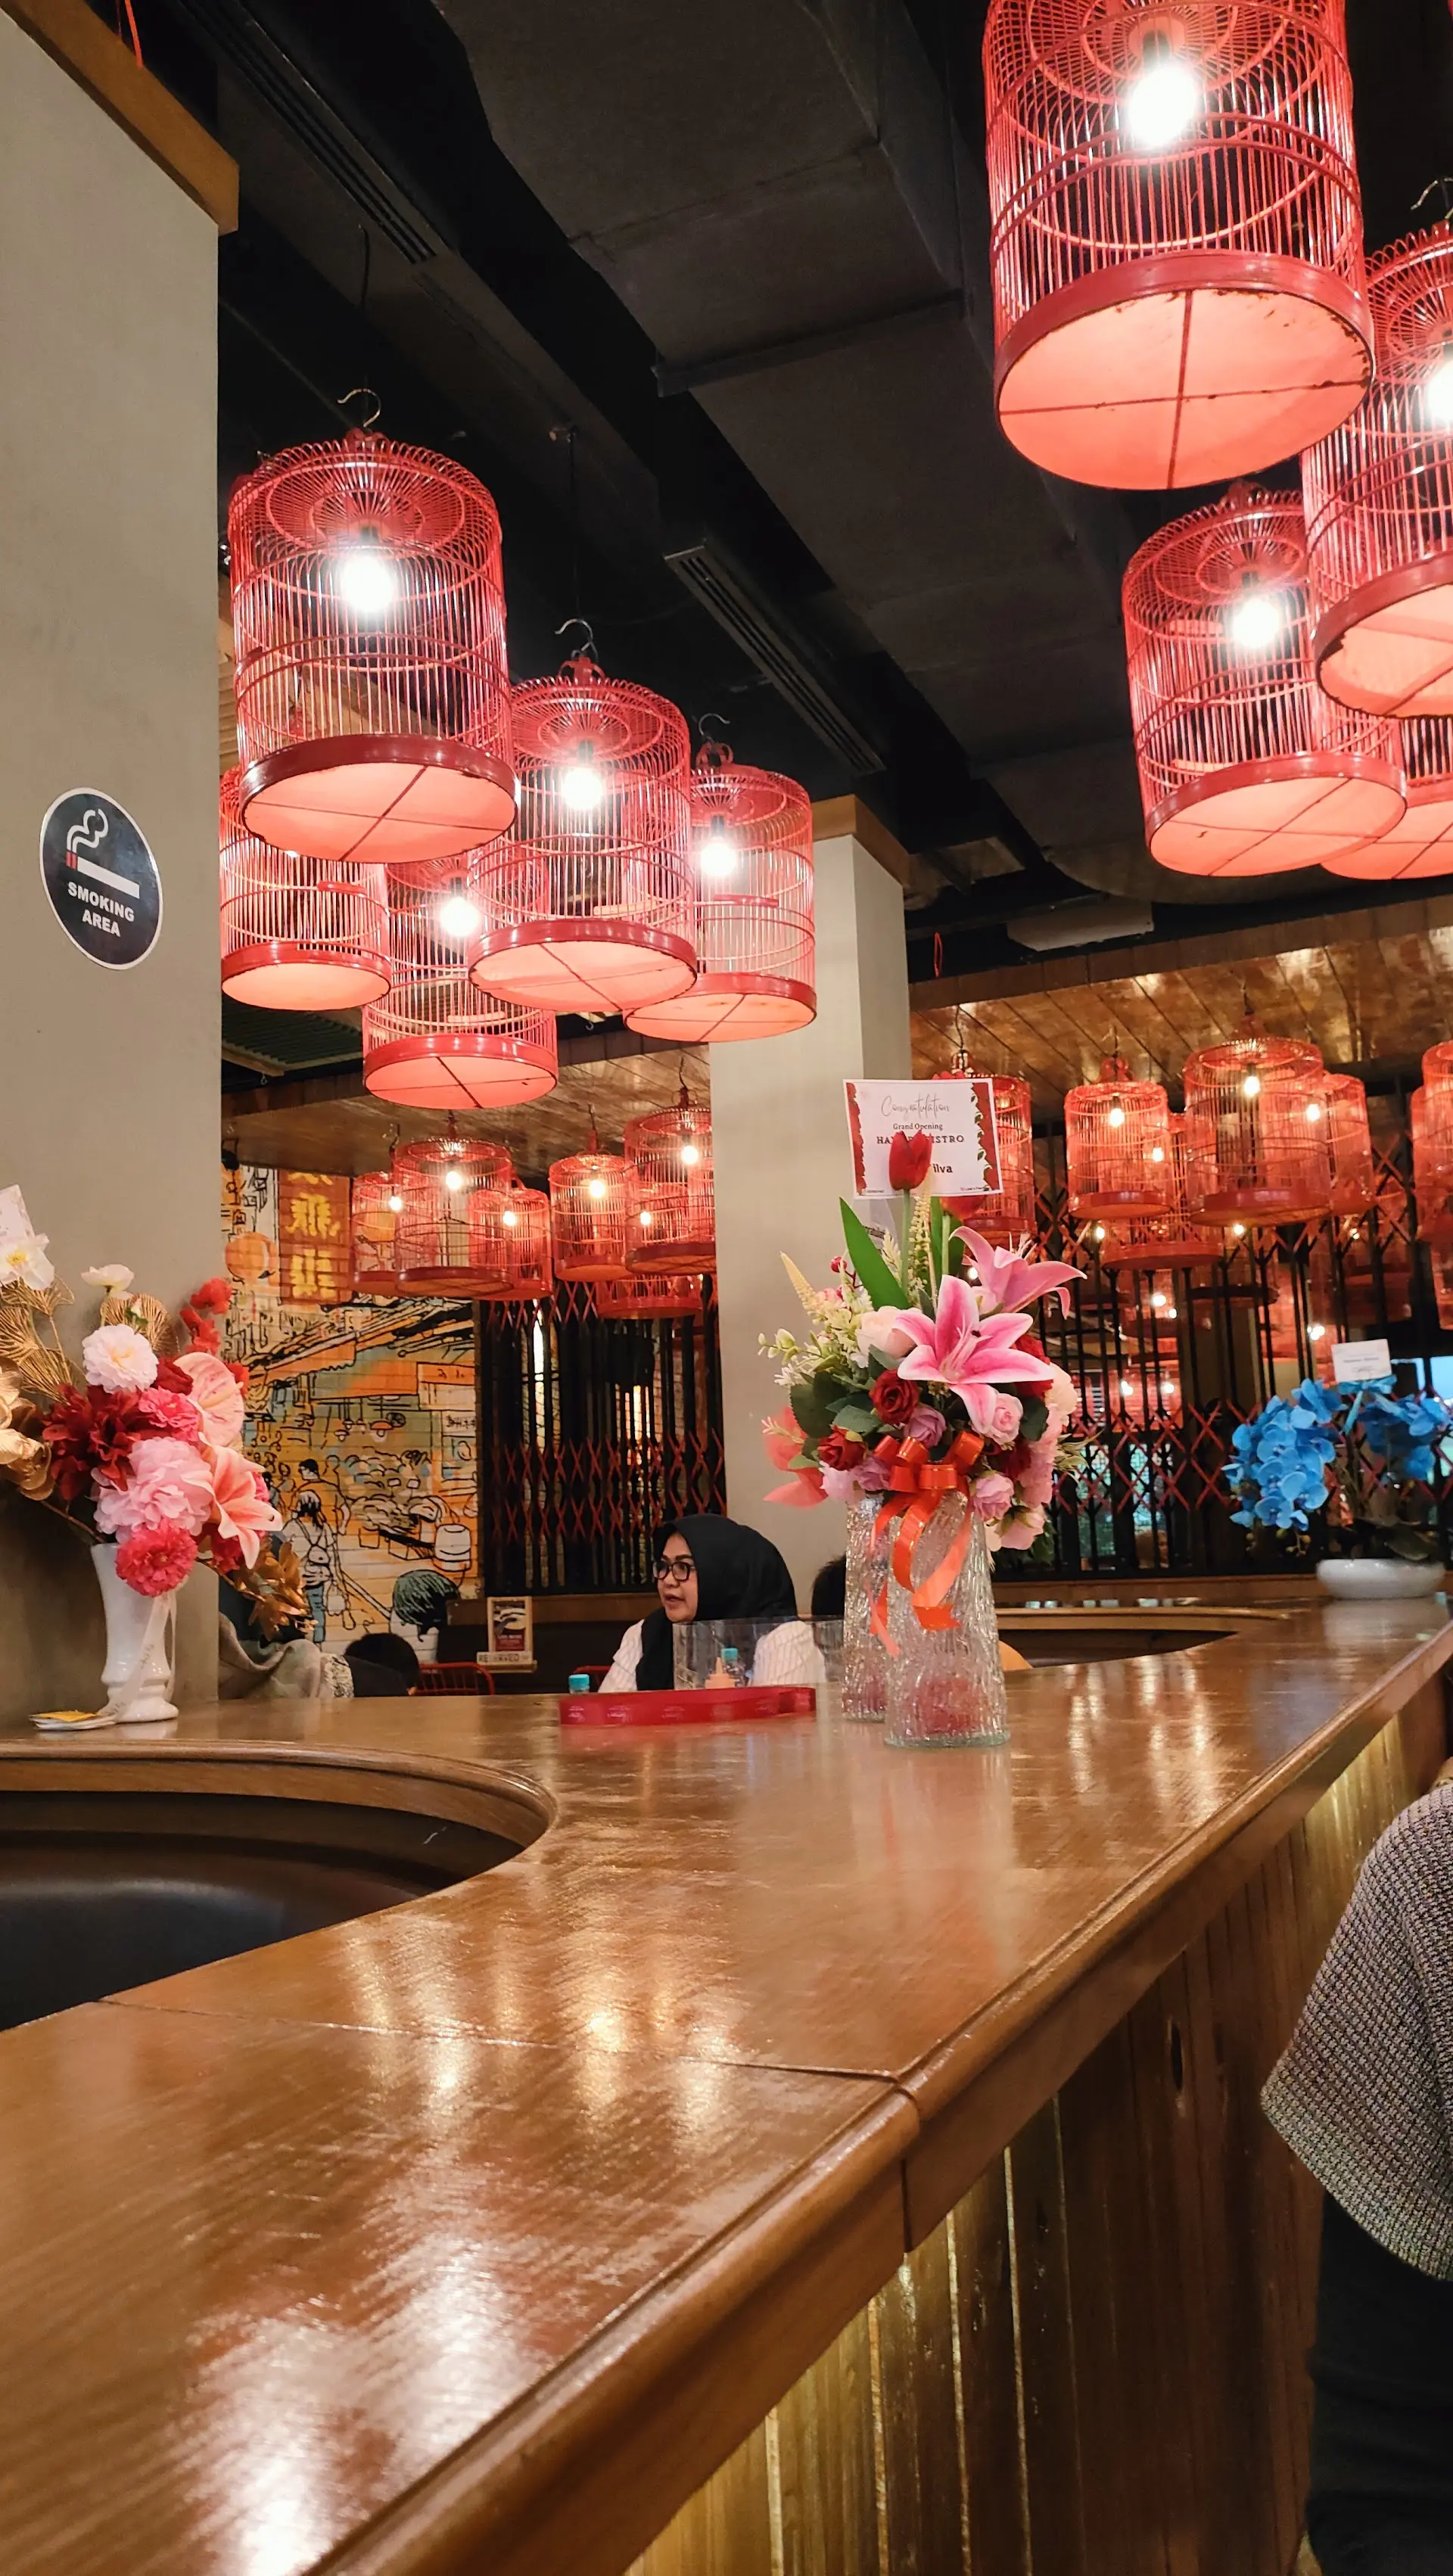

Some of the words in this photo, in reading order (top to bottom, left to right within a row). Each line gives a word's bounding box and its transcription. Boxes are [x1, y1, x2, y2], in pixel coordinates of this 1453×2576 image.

[67, 882, 135, 922] SMOKING
[82, 909, 121, 938] AREA
[914, 1122, 944, 1131] Opening
[928, 1134, 965, 1144] ISTRO
[932, 1163, 954, 1173] ilva
